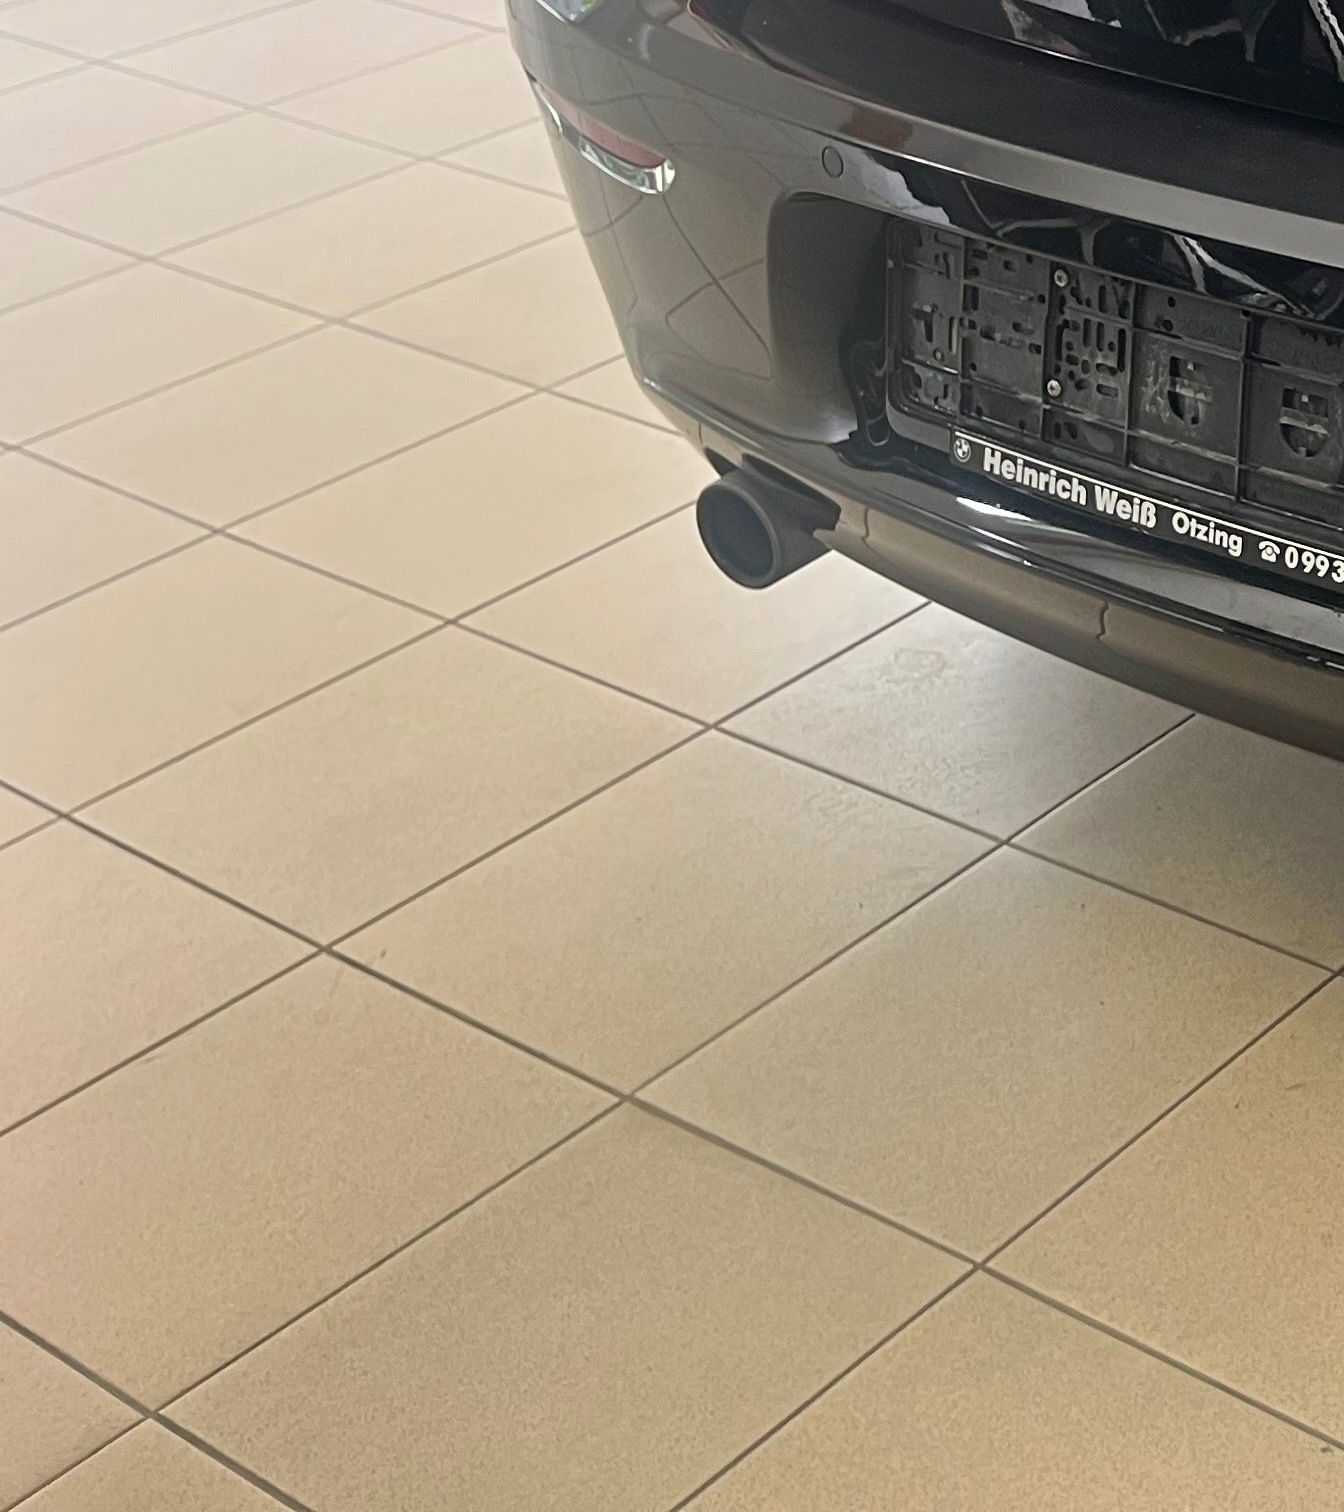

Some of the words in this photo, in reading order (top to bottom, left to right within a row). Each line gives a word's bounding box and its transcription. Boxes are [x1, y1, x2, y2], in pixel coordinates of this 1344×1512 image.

[982, 447, 1087, 506] Heinrich
[1094, 484, 1157, 529] Weiß
[1171, 511, 1243, 558] Otzing
